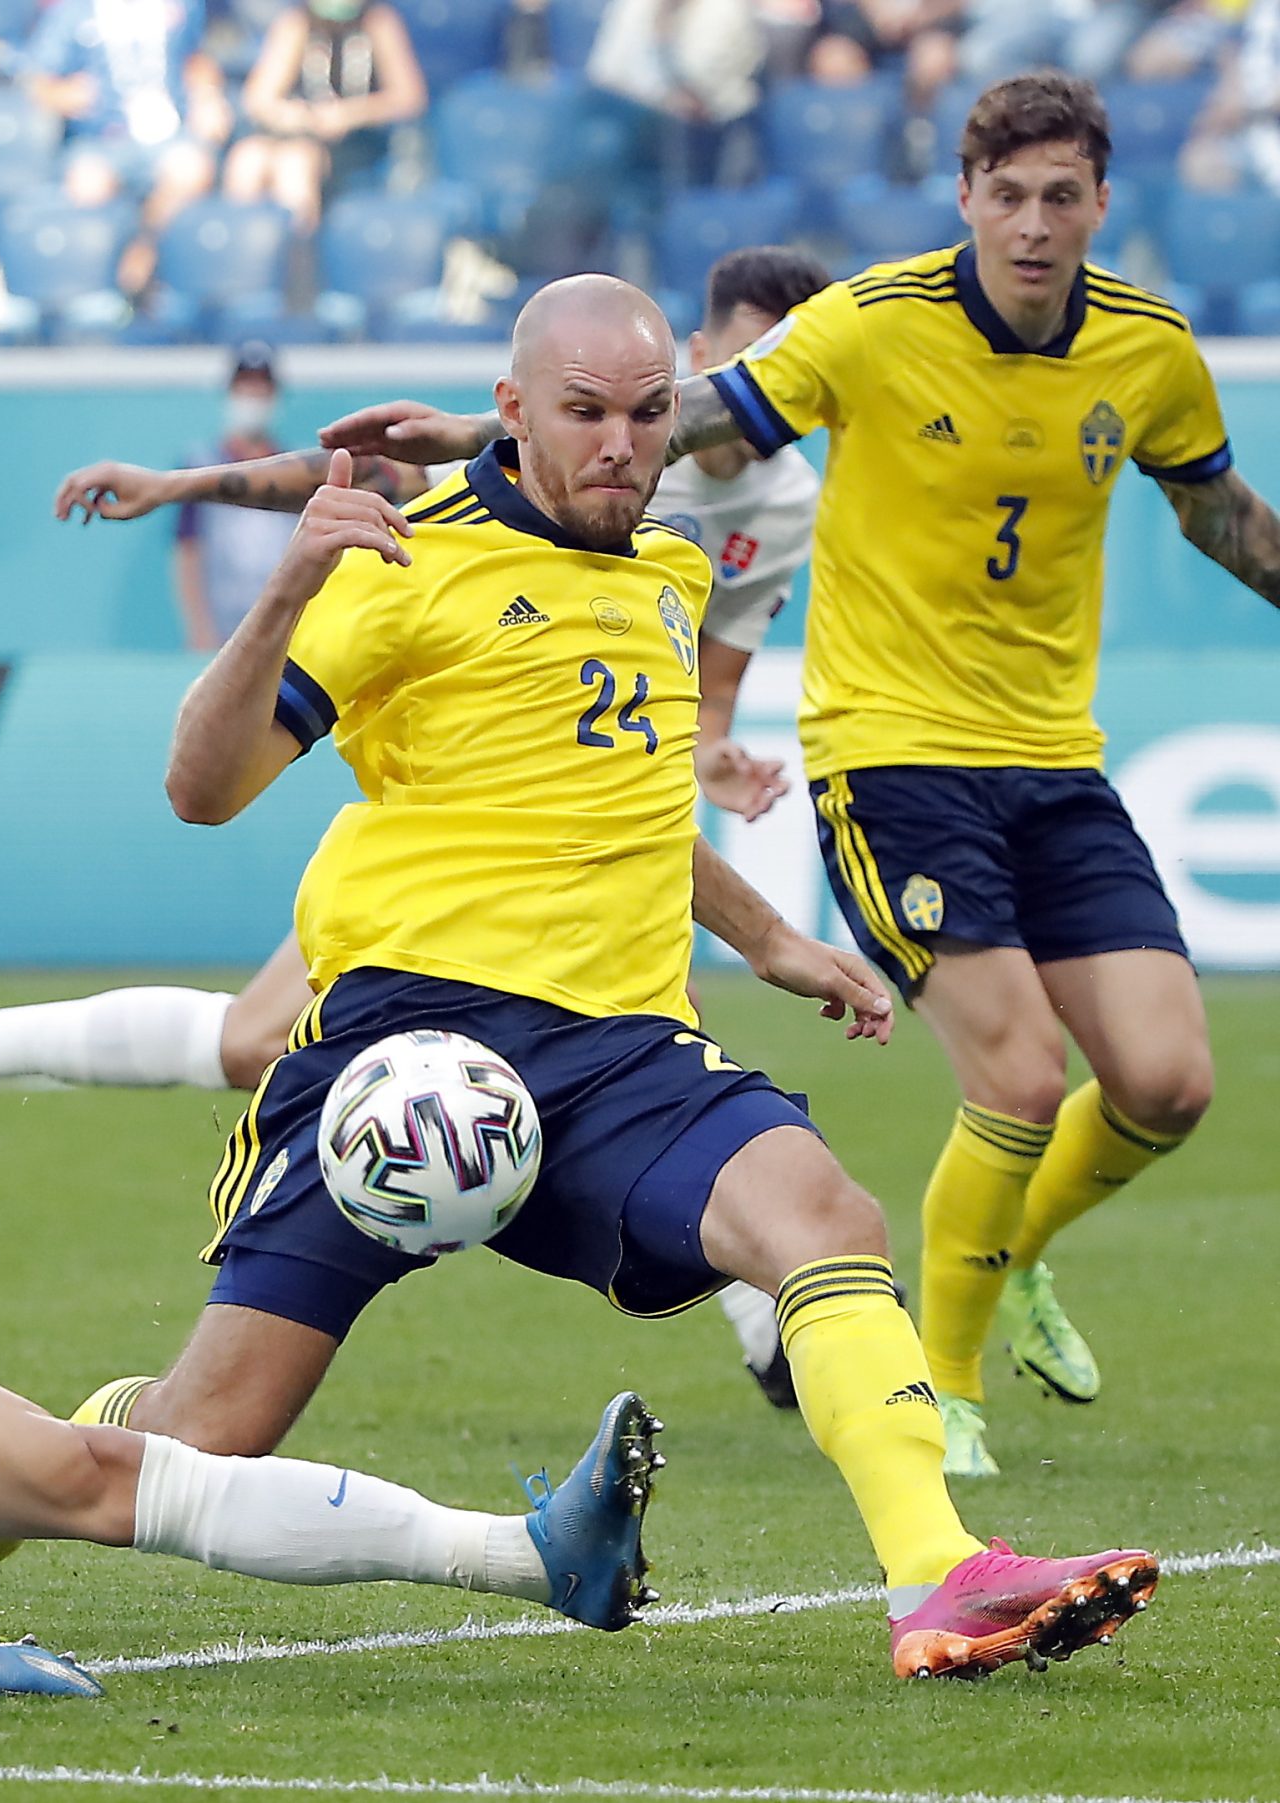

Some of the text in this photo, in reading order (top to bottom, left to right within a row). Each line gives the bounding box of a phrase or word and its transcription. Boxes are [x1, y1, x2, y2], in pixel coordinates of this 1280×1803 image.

[987, 496, 1028, 580] 3
[498, 613, 550, 627] adidas
[577, 659, 658, 755] 24
